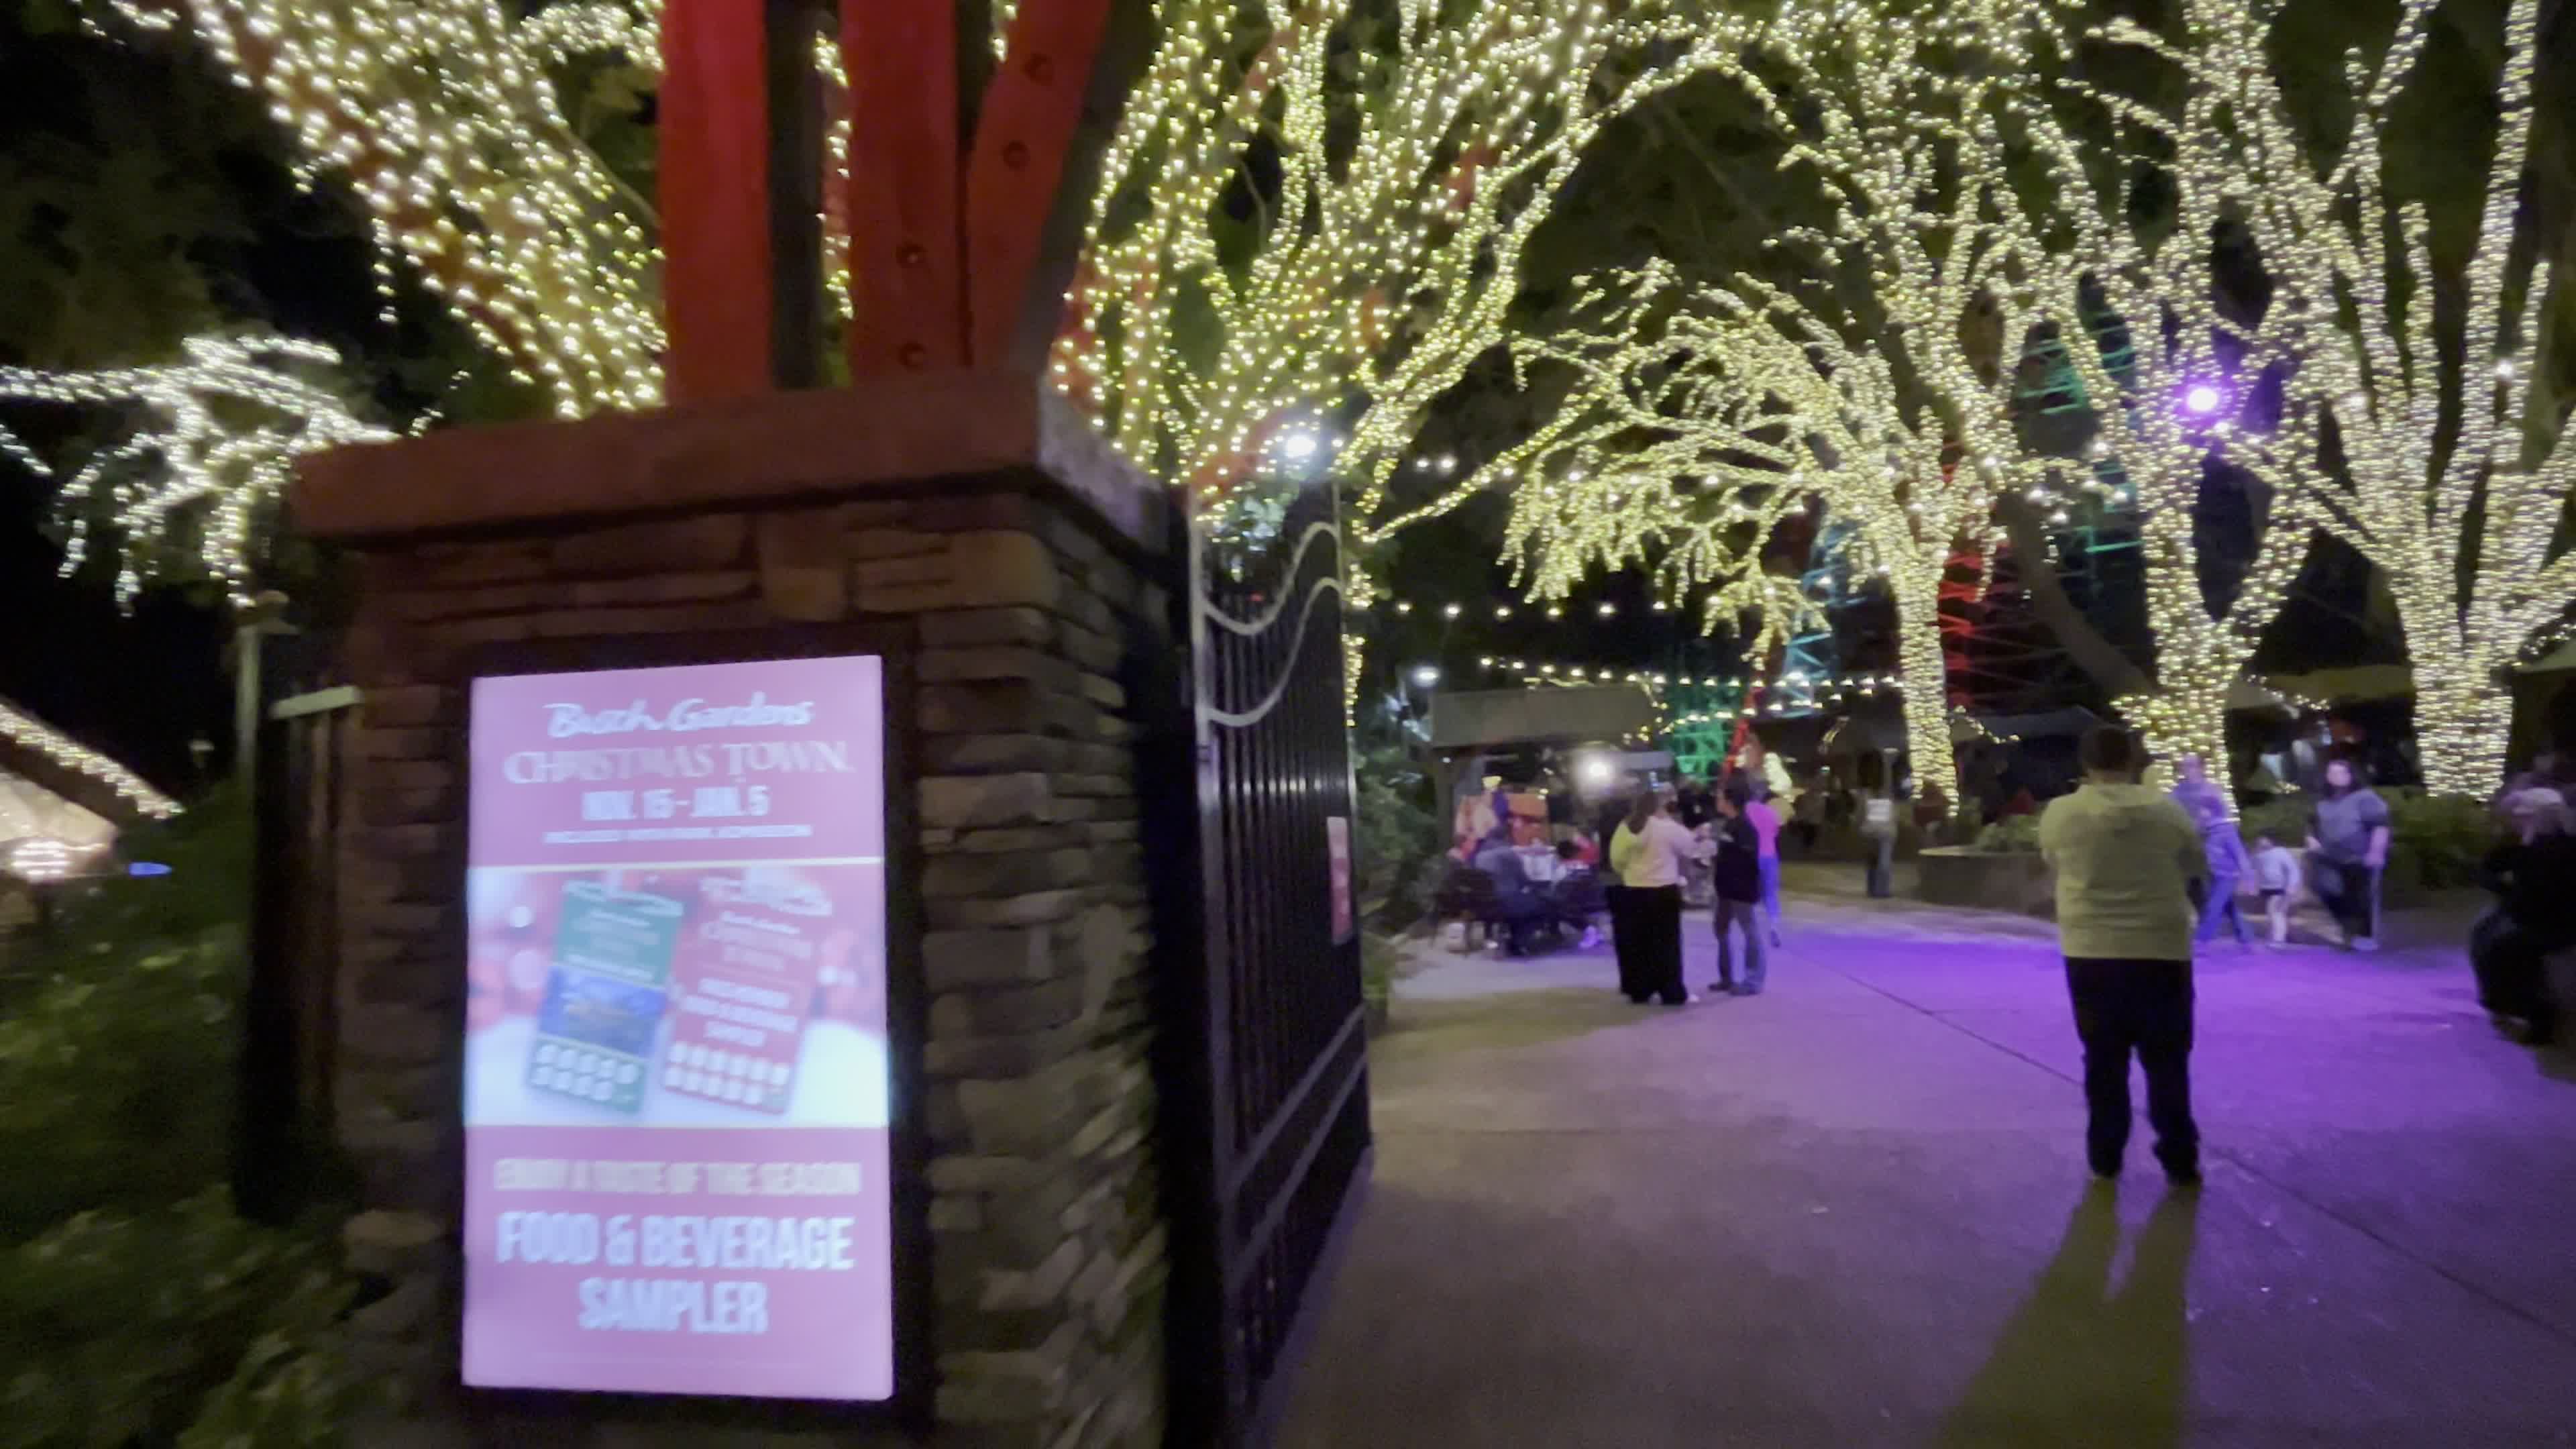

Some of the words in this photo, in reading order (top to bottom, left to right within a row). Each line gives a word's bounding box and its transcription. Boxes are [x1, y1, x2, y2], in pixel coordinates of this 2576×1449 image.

[505, 746, 713, 782] CHRISTMAS
[496, 1212, 599, 1263] FOOD
[607, 1215, 634, 1265] &
[643, 1215, 857, 1269] BEVERAGE
[579, 1279, 769, 1333] SAMPLER
